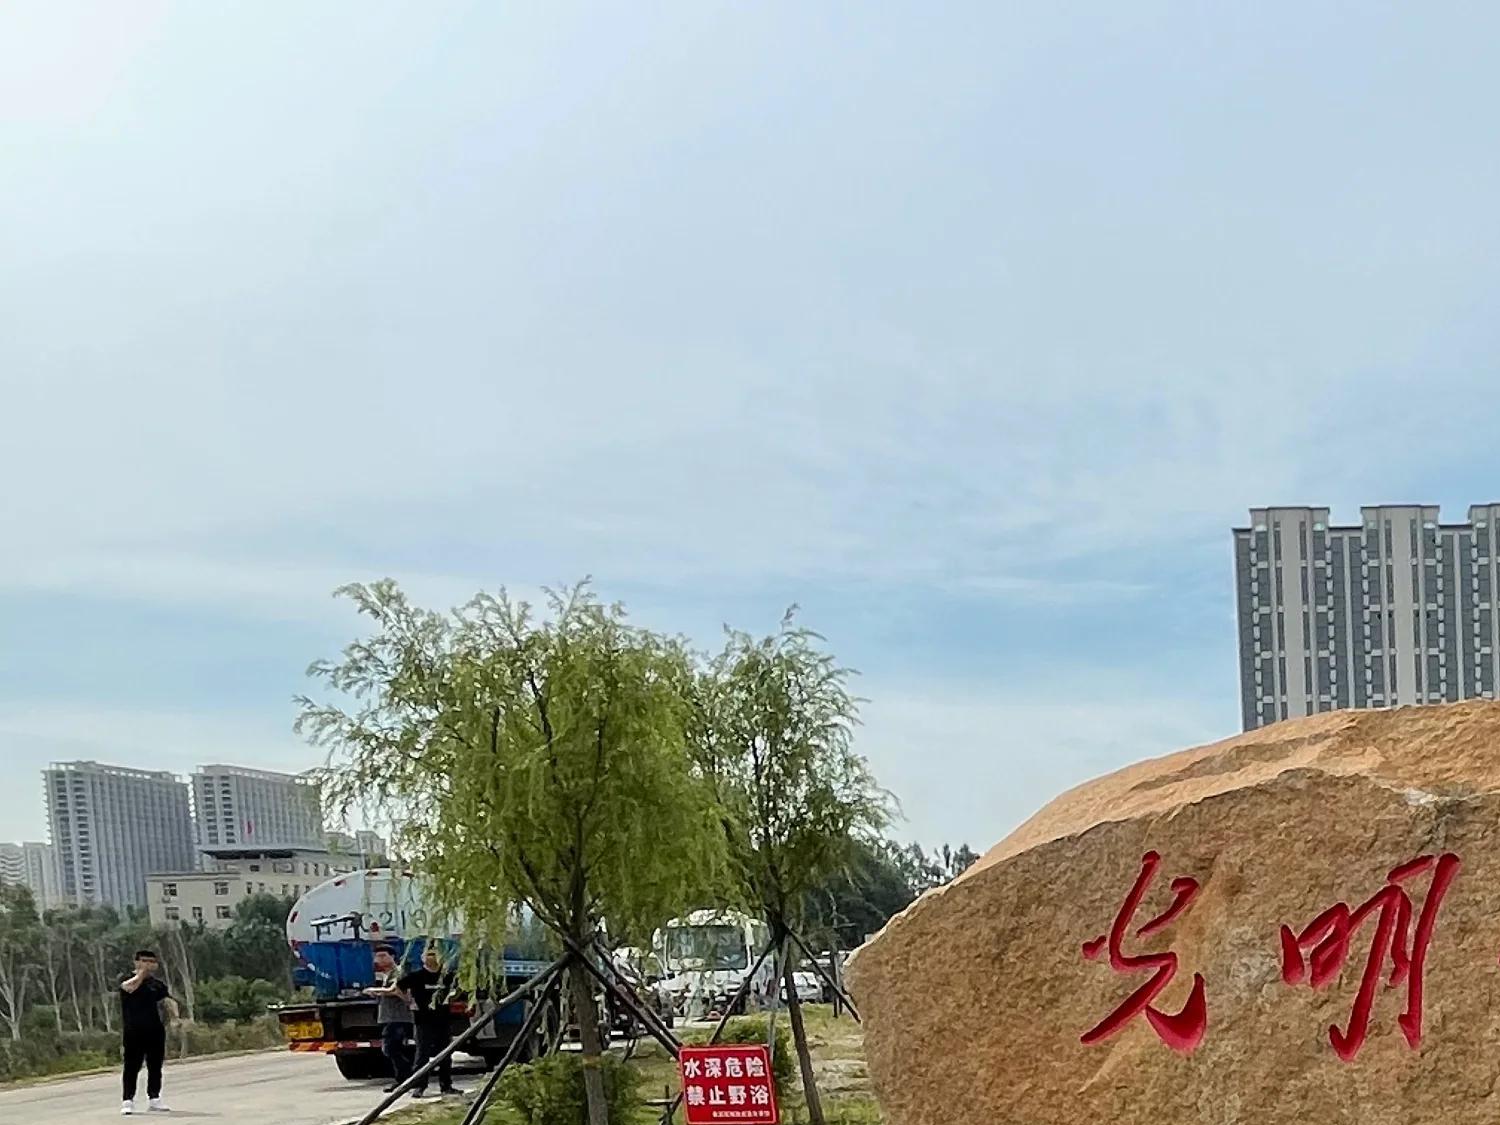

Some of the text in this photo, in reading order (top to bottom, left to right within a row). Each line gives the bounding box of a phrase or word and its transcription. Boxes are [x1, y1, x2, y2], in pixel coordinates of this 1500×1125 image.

[683, 1056, 766, 1079] 水深危险
[686, 1084, 770, 1106] 禁止野浴
